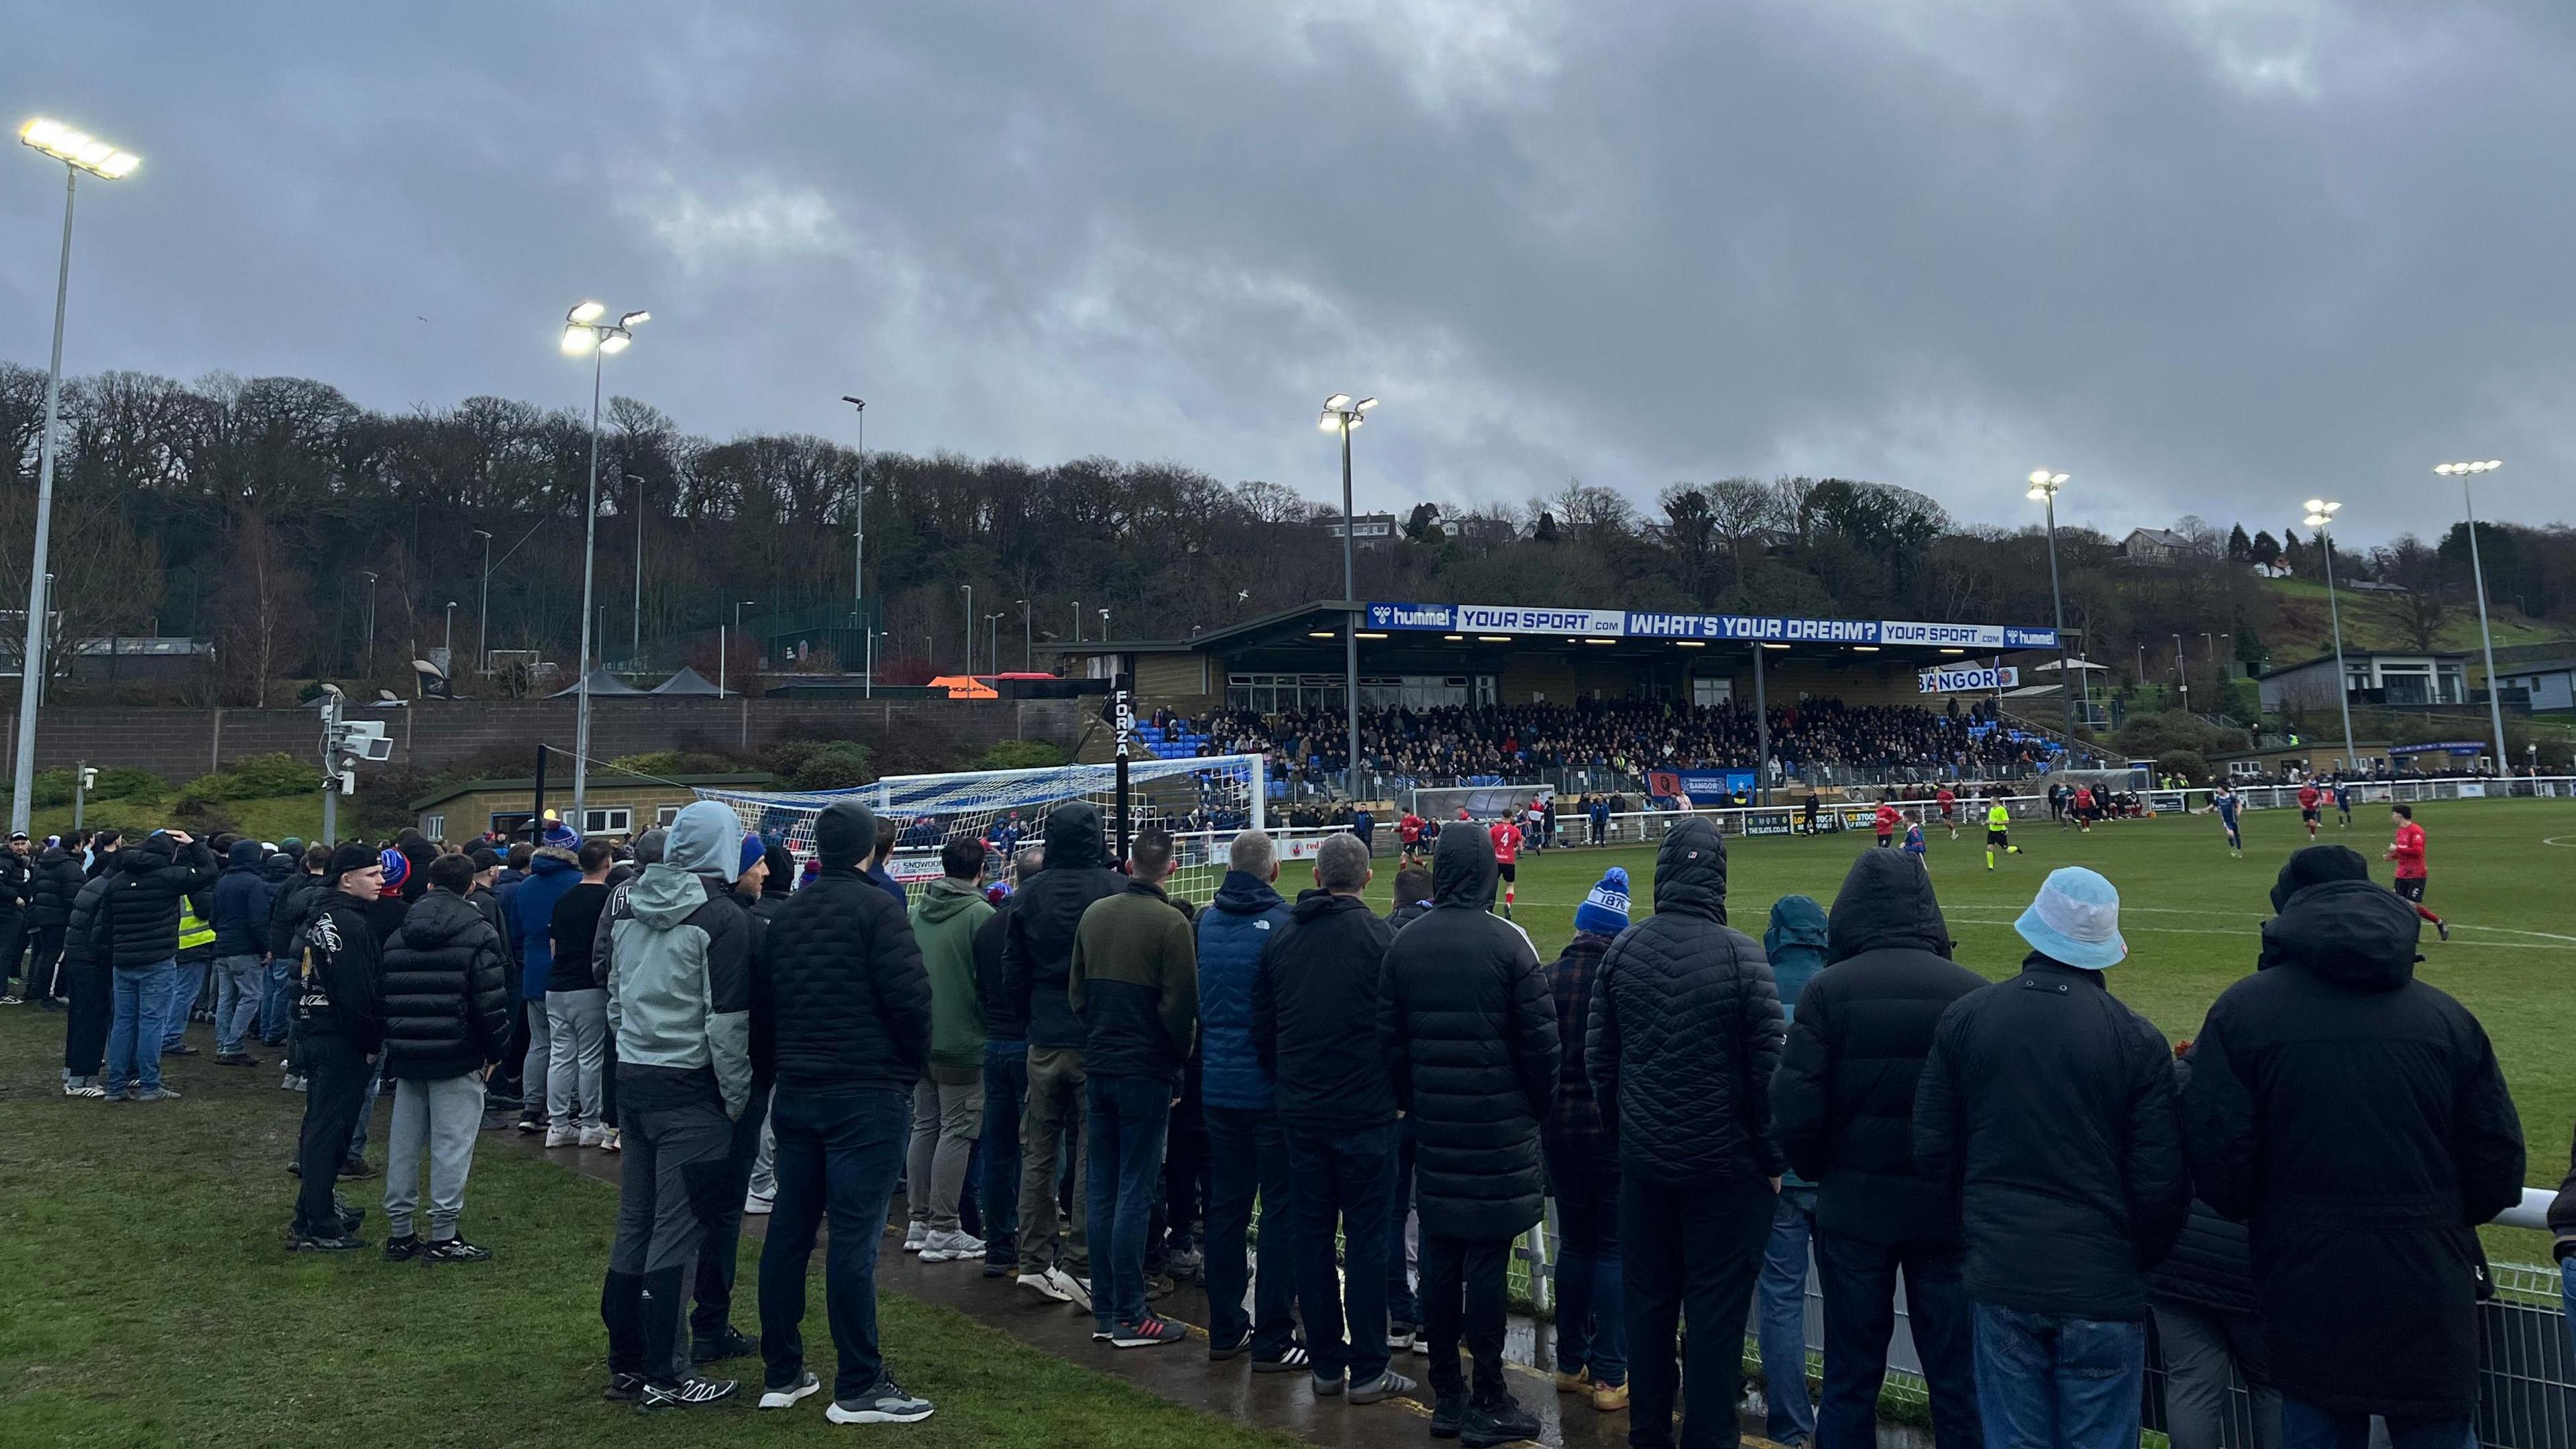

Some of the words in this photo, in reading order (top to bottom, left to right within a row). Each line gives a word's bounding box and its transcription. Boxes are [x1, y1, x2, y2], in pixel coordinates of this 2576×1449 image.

[1393, 606, 1449, 626] hummel
[1464, 610, 1517, 627] YOUR
[1523, 613, 1589, 629] SPORT
[1631, 614, 1718, 637] WHAT'S
[1723, 618, 1782, 638] YOUR
[1787, 619, 1877, 641] DREAM?
[1886, 625, 1925, 640] YOUR
[1929, 628, 1978, 642] SPORT
[2019, 631, 2055, 645] hummel
[1919, 671, 1994, 692] BANGOR
[1116, 690, 1129, 757] FORZA
[1500, 832, 1509, 847] 4
[1601, 894, 1625, 910] 1876
